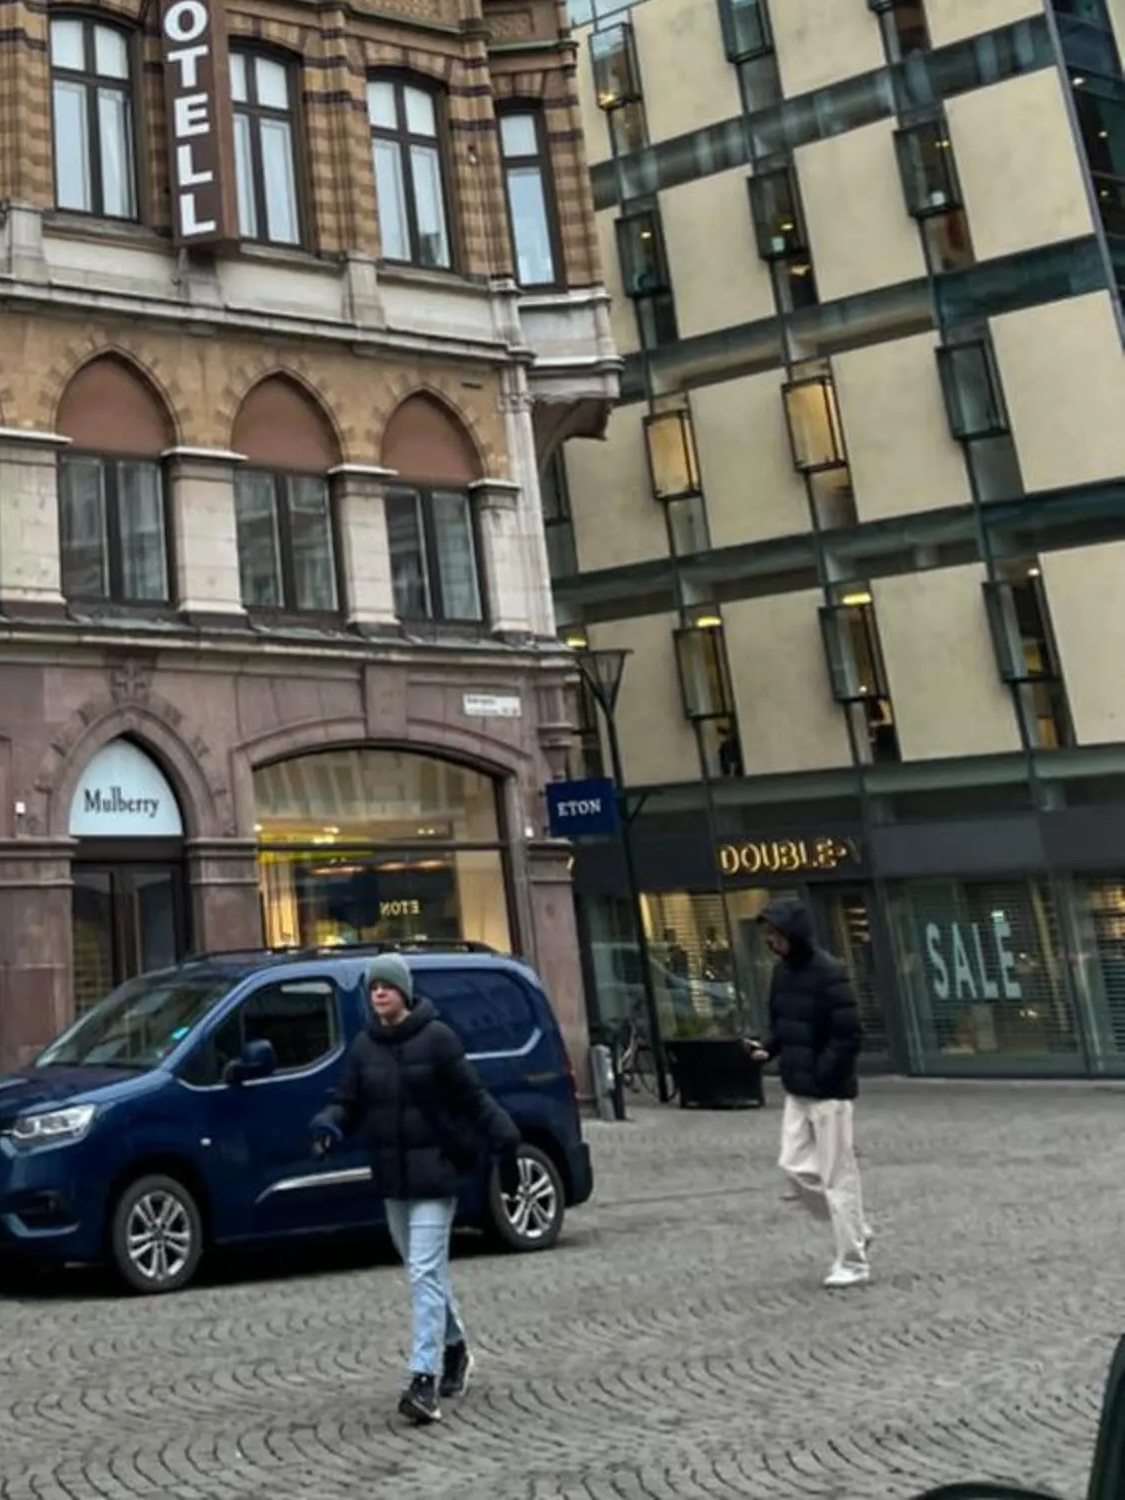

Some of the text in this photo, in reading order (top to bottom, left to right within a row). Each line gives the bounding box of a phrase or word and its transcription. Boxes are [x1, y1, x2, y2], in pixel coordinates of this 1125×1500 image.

[84, 786, 159, 818] Mulberry
[556, 798, 601, 817] ETON
[926, 922, 1022, 998] SALE
